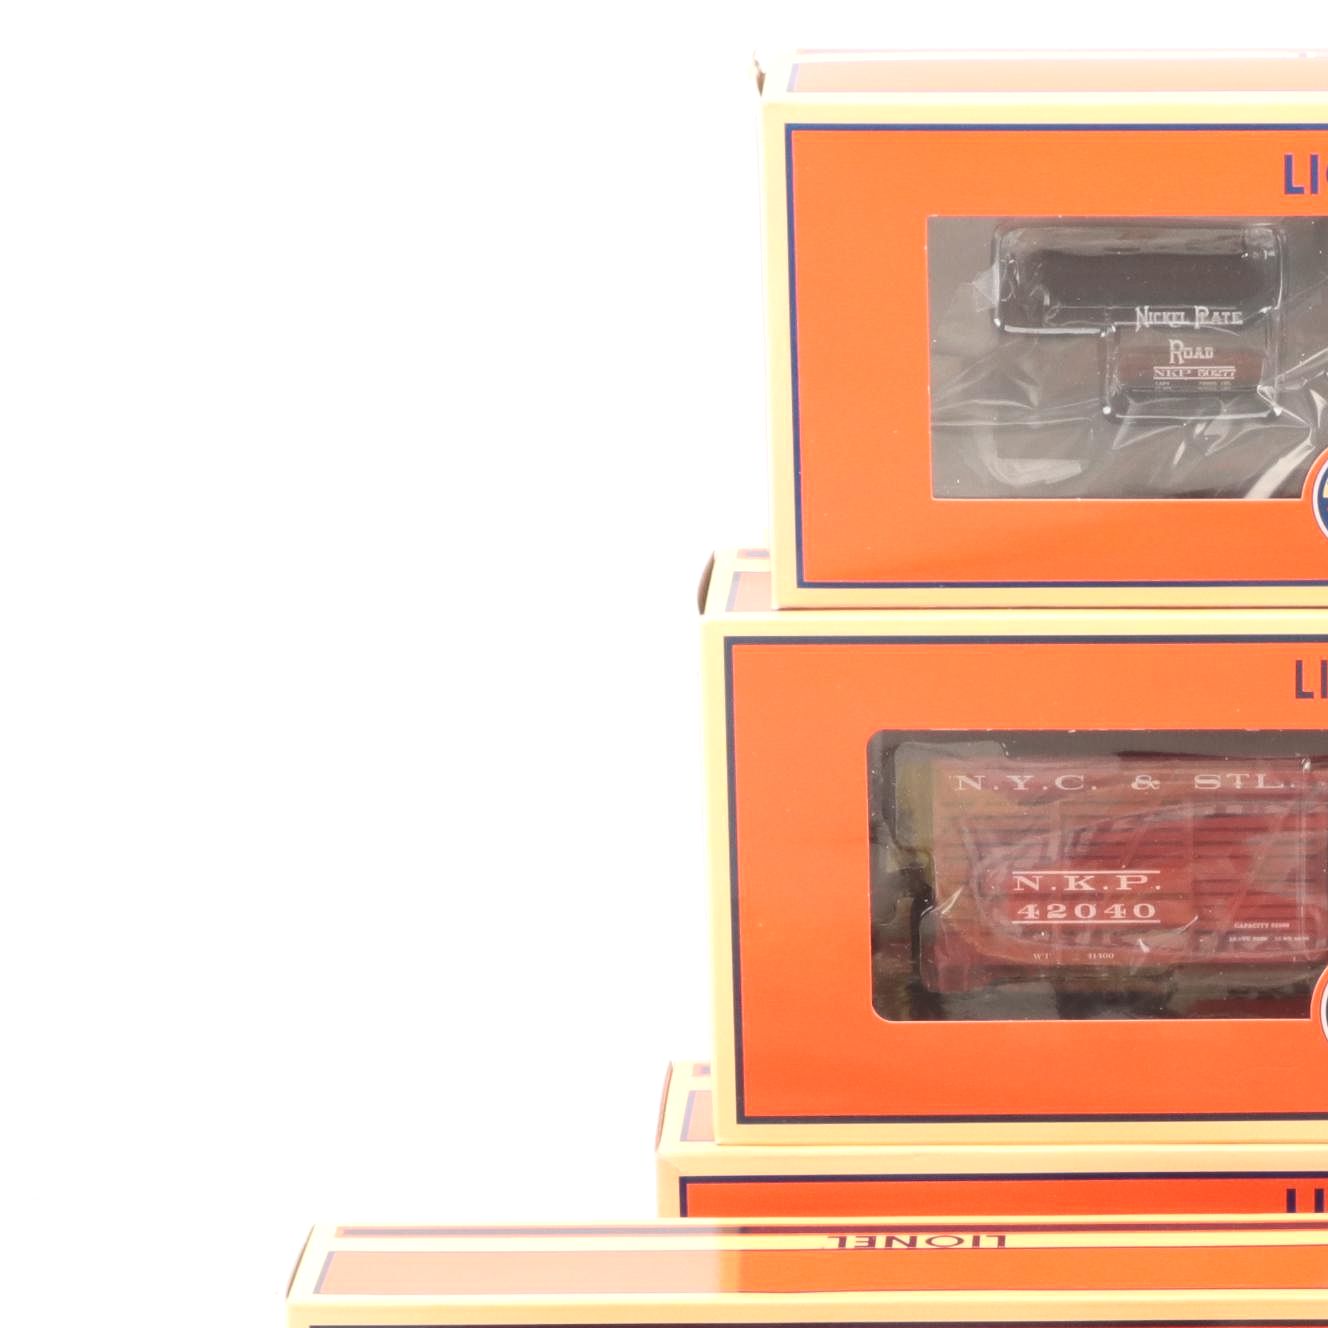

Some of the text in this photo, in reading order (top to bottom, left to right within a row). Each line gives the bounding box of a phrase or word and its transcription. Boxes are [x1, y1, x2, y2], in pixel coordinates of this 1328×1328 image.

[1168, 339, 1214, 364] ROAD
[954, 774, 1098, 792] N.Y.C.
[1131, 774, 1161, 791] &
[1013, 874, 1162, 891] N.K.P.
[1017, 903, 1157, 920] 42040
[827, 1235, 1006, 1248] LIONEL
